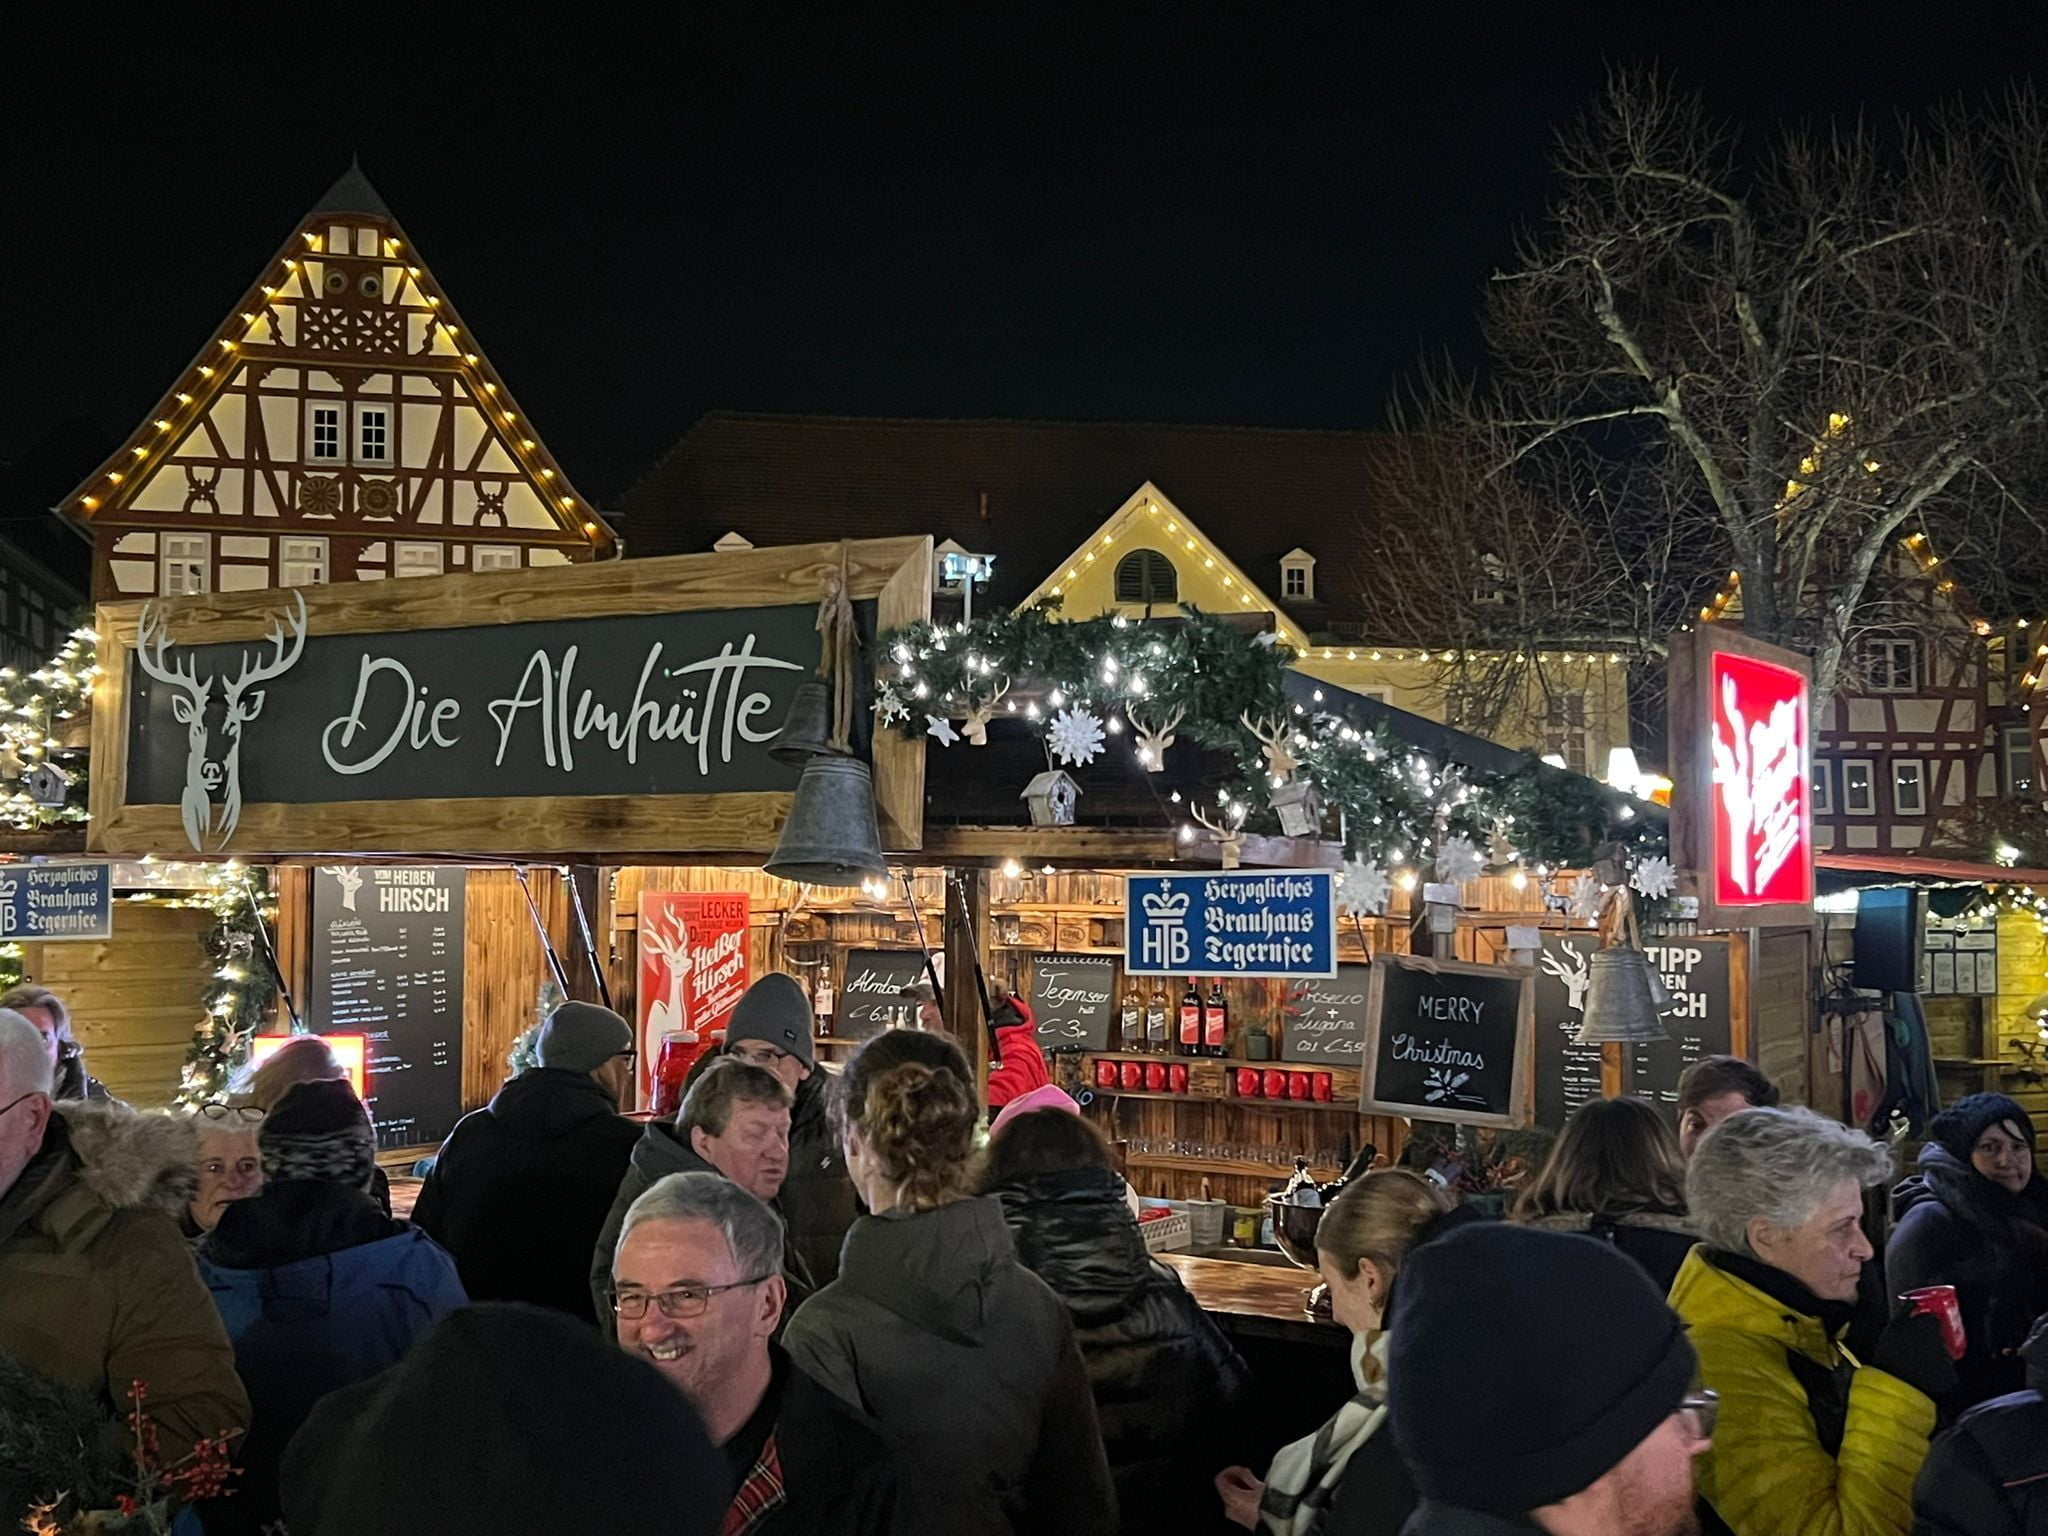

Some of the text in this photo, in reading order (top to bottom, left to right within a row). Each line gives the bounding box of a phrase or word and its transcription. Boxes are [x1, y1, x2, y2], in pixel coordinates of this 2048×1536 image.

[322, 633, 805, 776] Die Almhütte
[27, 866, 98, 888] Herzogliches
[1204, 876, 1314, 905] Herzogliches
[26, 888, 98, 912] Brauhaus
[380, 887, 449, 912] HIRSCH
[701, 901, 744, 919] LECKER
[26, 909, 97, 934] Tegernsee
[1204, 906, 1315, 940] Brauhaus
[1142, 918, 1191, 970] HTB
[1204, 935, 1315, 971] Tegernsee
[1642, 947, 1702, 973] TIPP
[1418, 995, 1485, 1024] MERRY
[1391, 1033, 1485, 1070] Christmas
